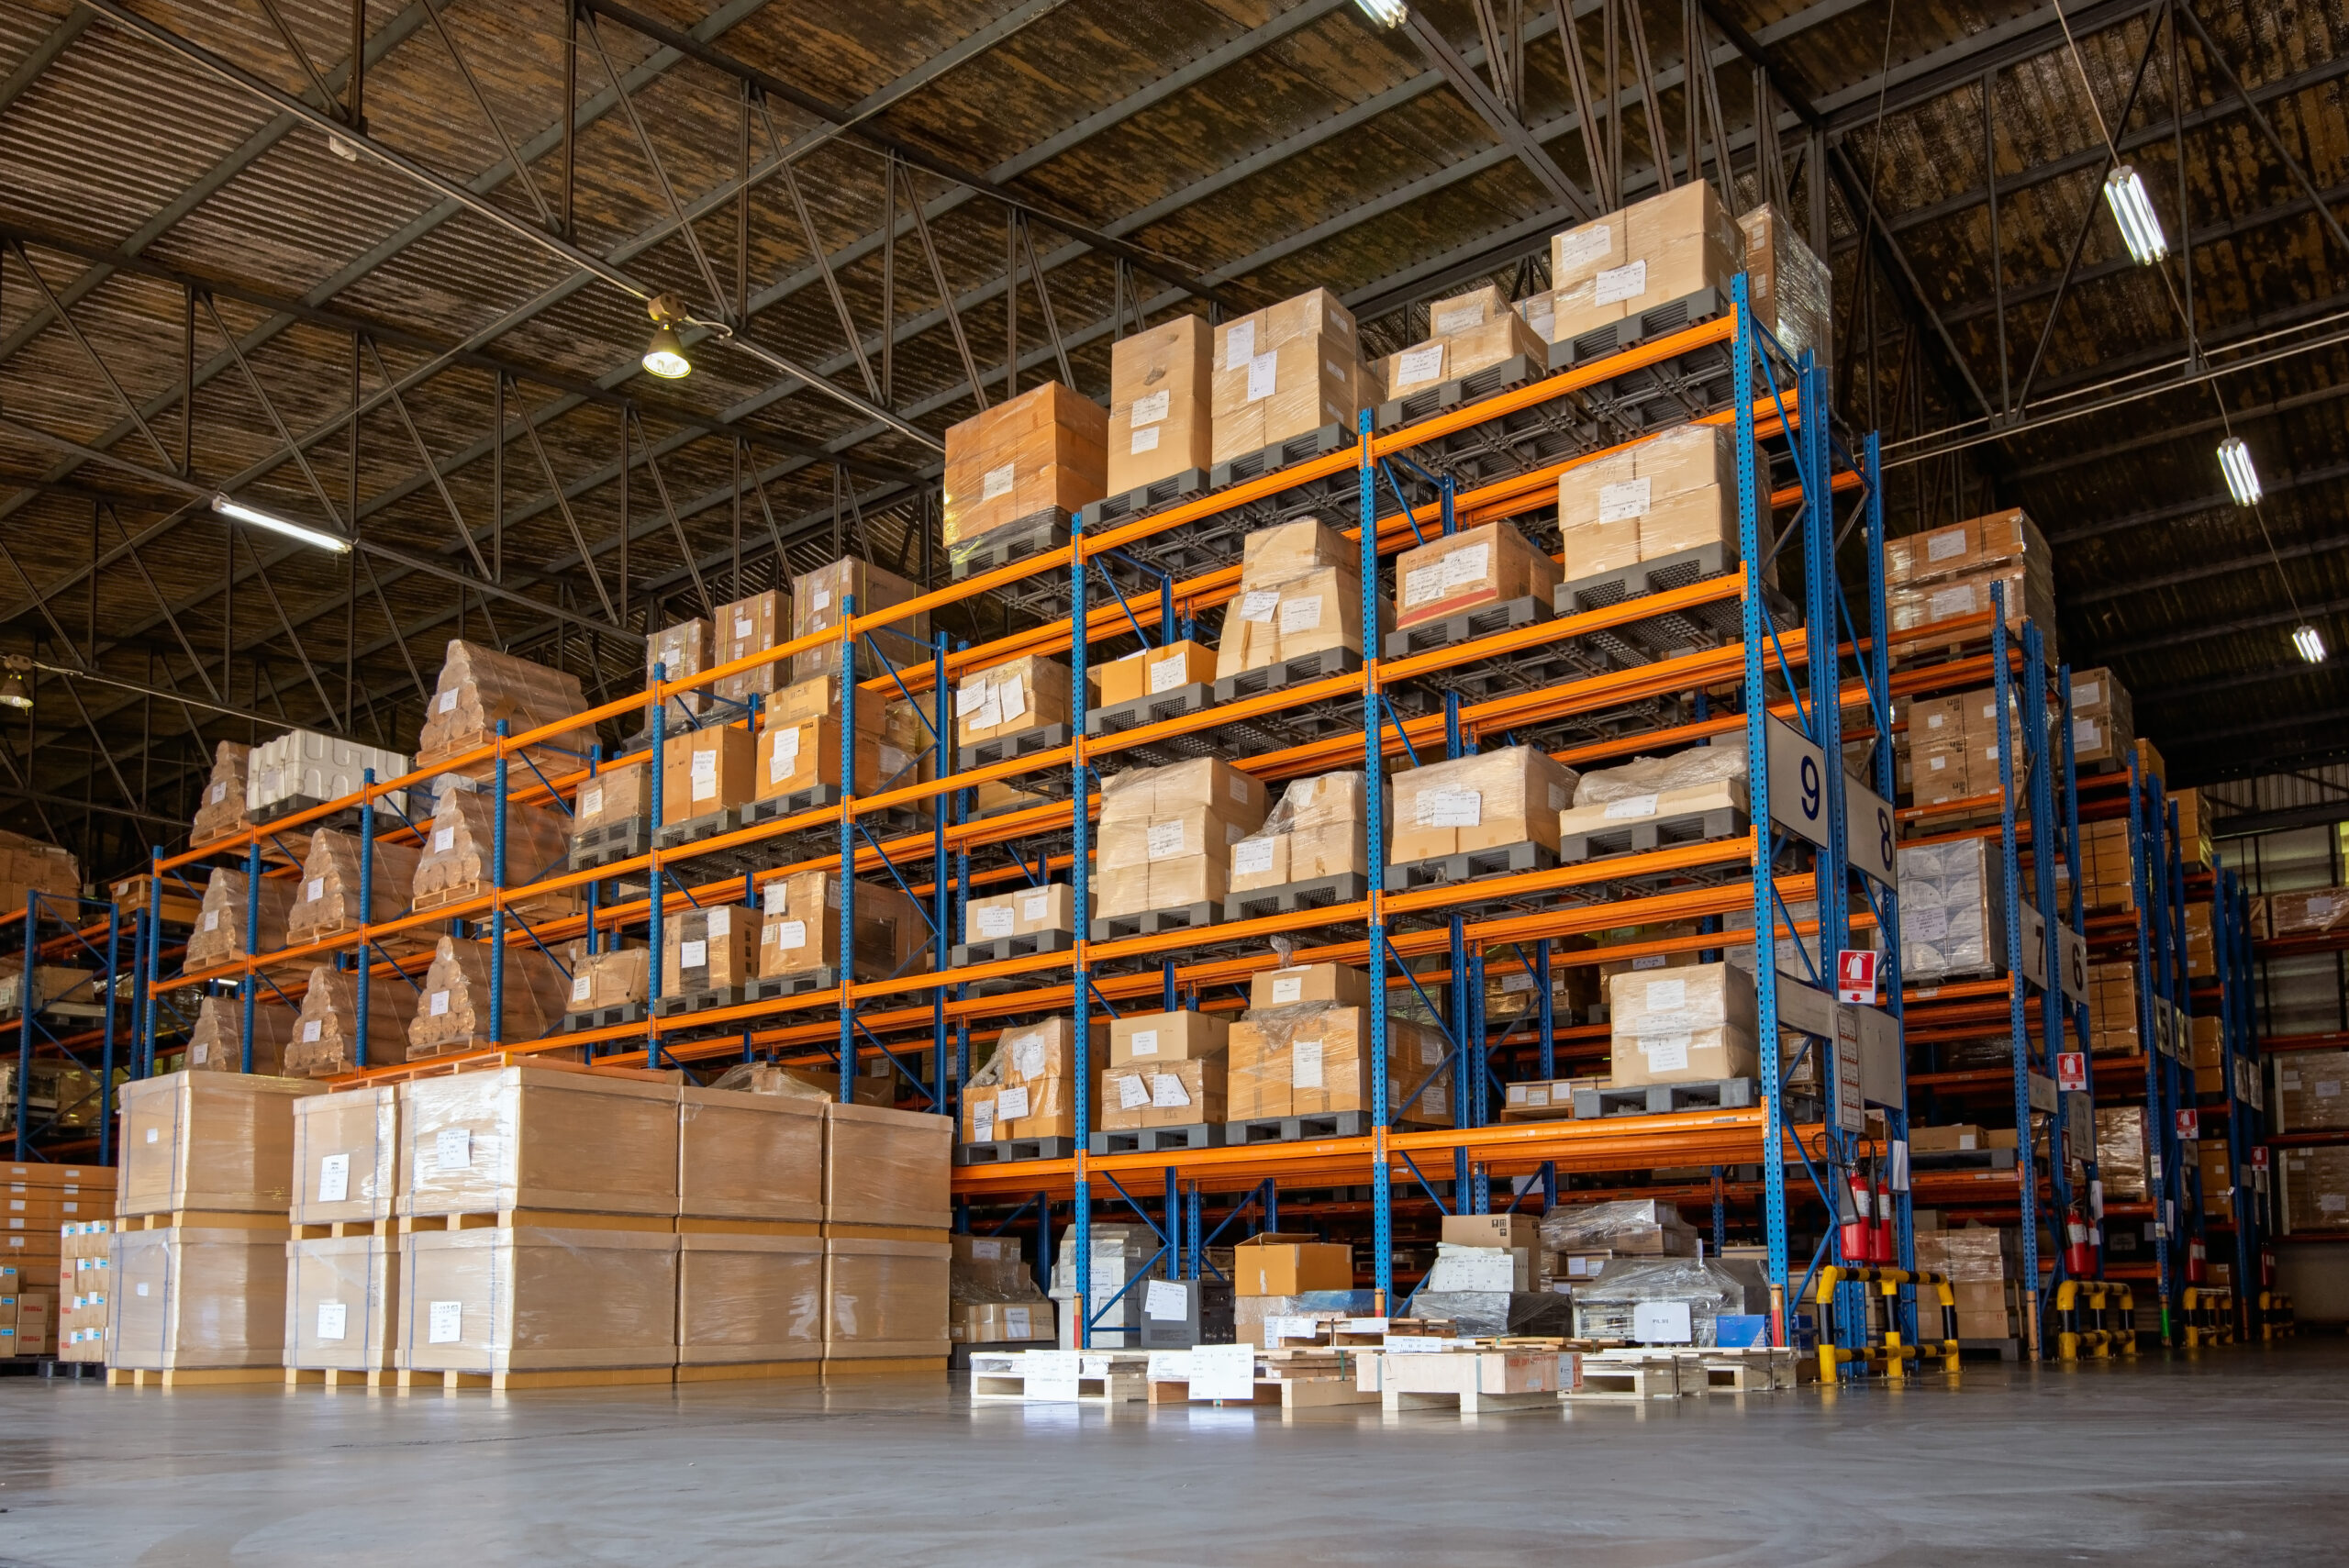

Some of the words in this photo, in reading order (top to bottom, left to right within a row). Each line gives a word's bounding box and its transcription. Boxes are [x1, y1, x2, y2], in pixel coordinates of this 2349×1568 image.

[1800, 755, 1820, 821] 9
[1877, 806, 1893, 873] 8
[2035, 924, 2044, 976] 7
[2072, 942, 2084, 992] 6
